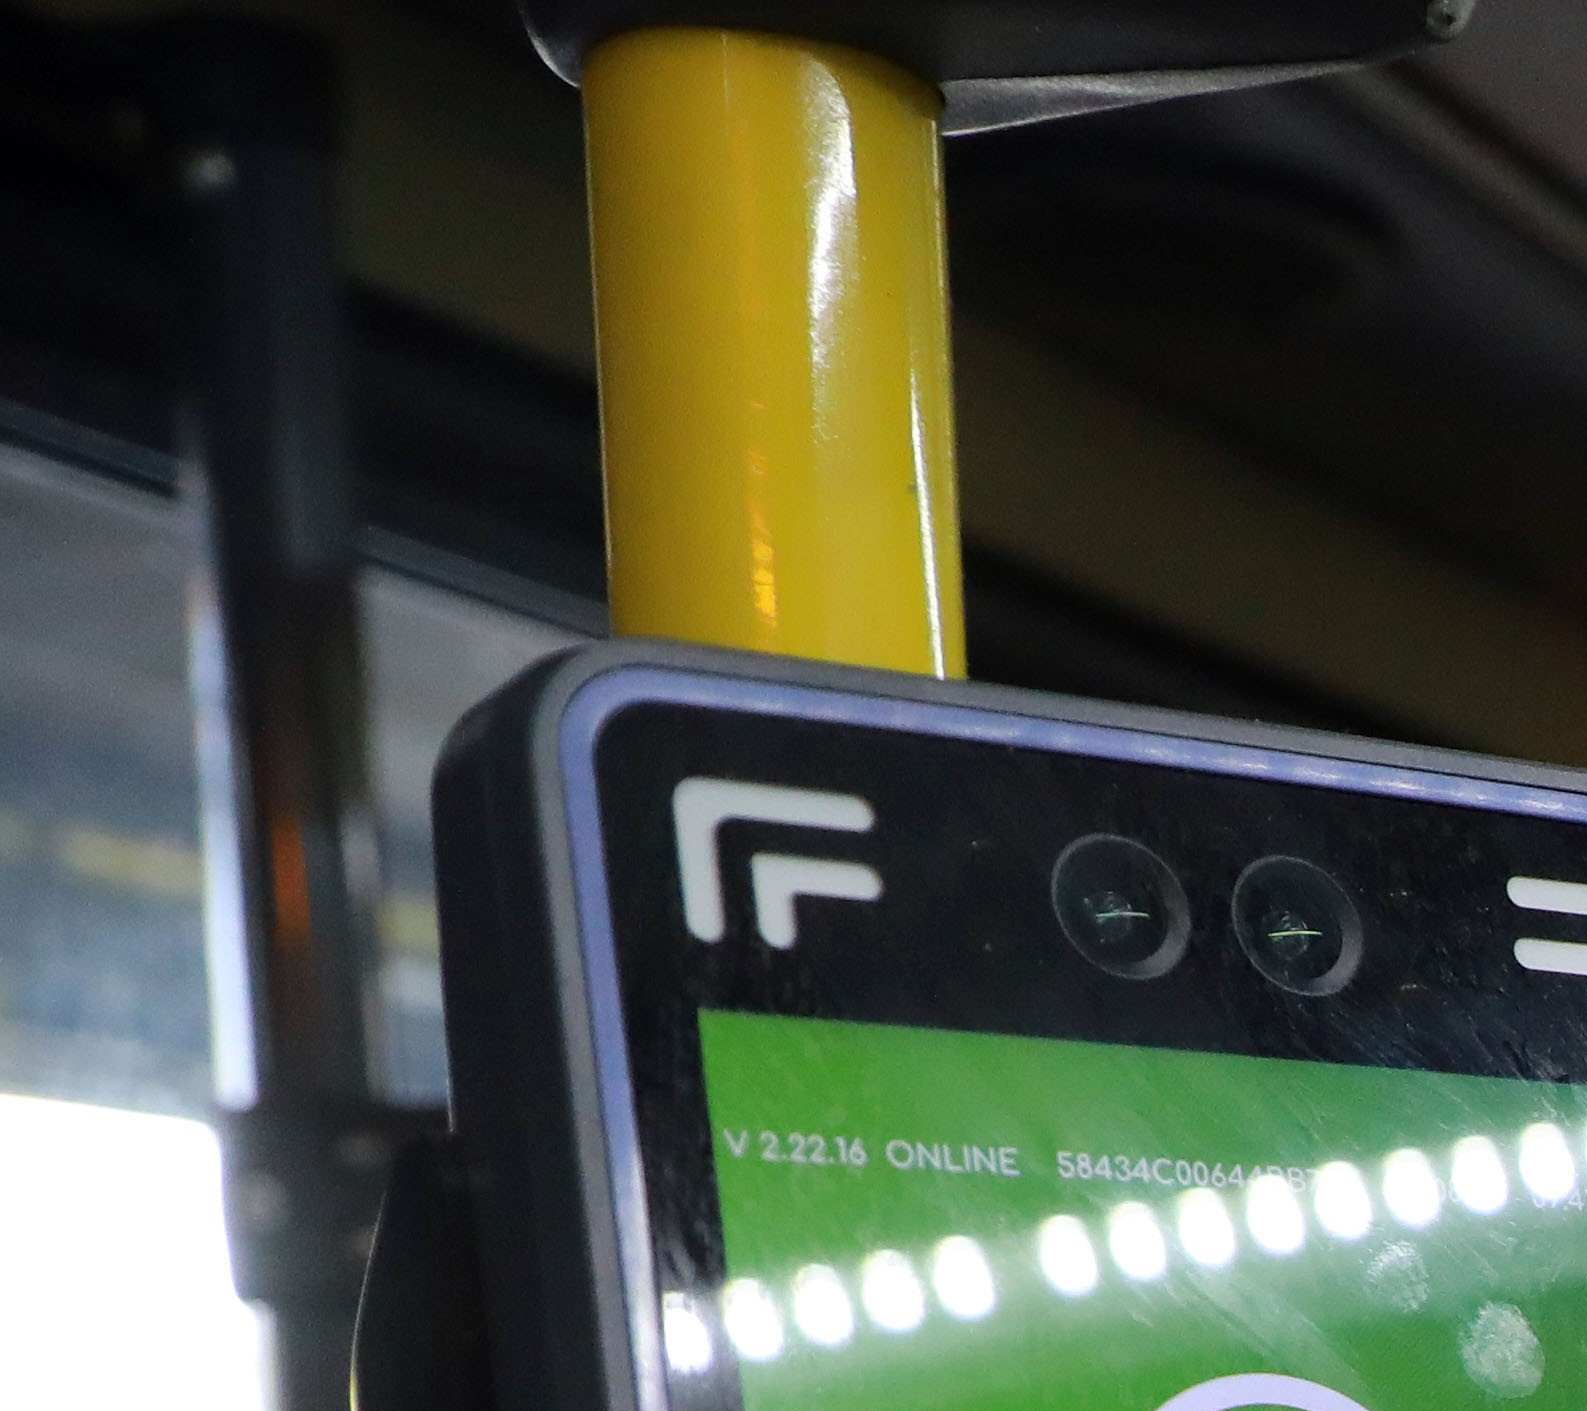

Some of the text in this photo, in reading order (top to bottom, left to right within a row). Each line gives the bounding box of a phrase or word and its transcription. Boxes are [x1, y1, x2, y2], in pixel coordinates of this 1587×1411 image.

[723, 1128, 748, 1158] V
[759, 1130, 868, 1168] 2.22.16
[886, 1139, 1021, 1177] ONLINE
